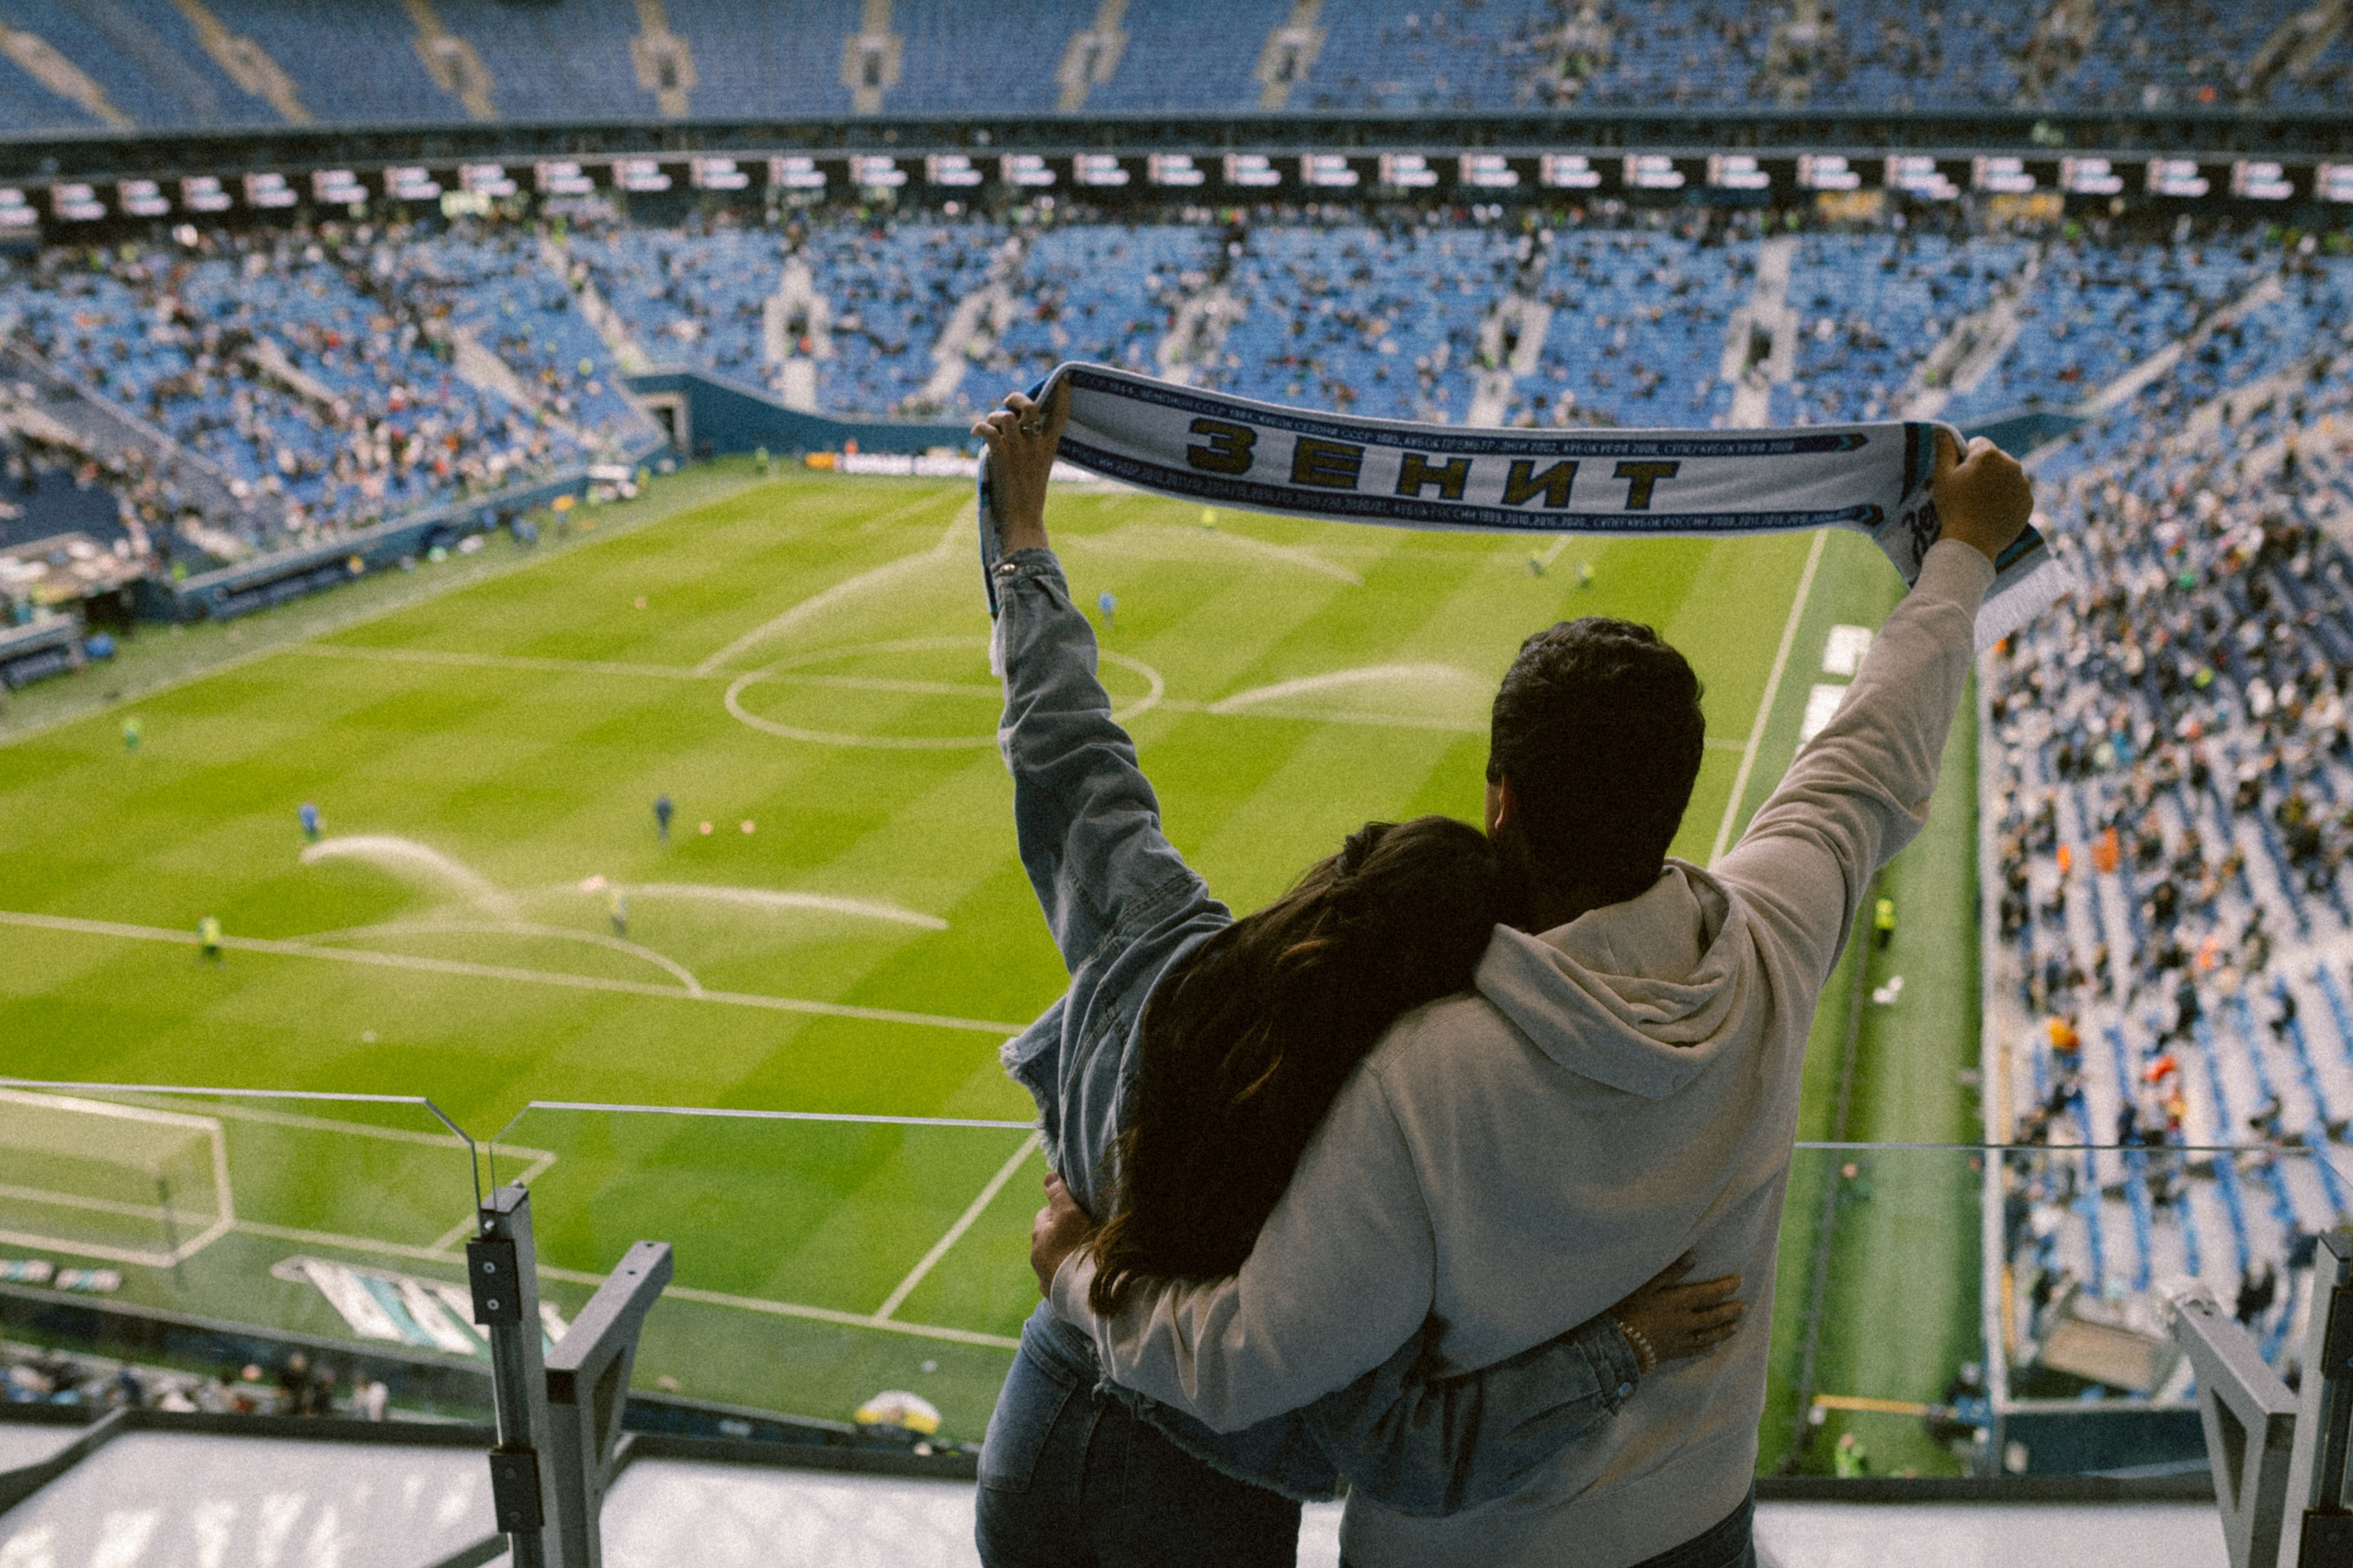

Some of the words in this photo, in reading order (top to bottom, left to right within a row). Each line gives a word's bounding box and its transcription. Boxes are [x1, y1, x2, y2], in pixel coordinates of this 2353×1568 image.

[1194, 401, 1227, 415] СССР
[1340, 428, 1373, 443] СССР
[1403, 437, 1438, 450] КУБОК
[1563, 442, 1597, 454] КУБОК
[1663, 442, 1734, 455] СУПЕРКУБОК
[1187, 418, 1681, 510] ЗЕНИТ
[1592, 517, 1662, 529] СУПЕРКУБОК
[1664, 517, 1709, 528] РОССИИ
